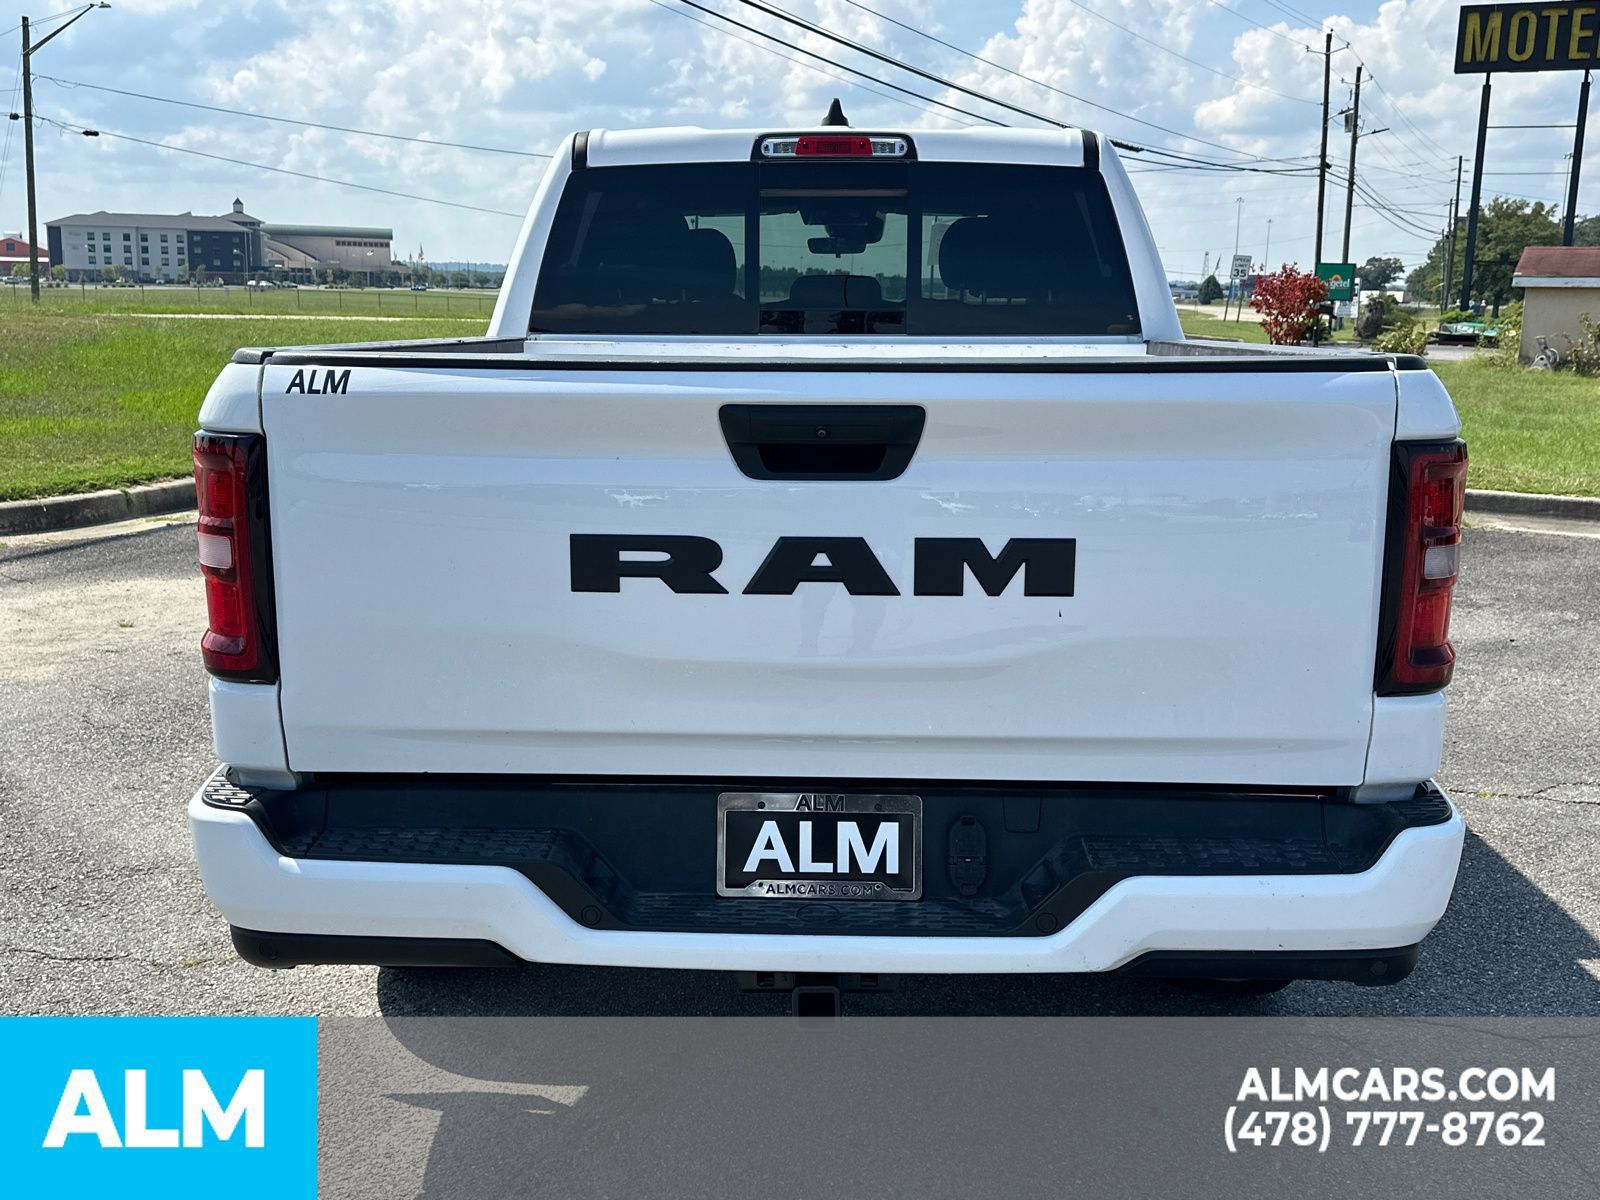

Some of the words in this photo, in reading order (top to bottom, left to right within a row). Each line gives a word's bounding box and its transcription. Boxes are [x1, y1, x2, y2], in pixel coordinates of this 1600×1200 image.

[1462, 7, 1600, 64] MOTE
[1233, 268, 1247, 278] 35
[285, 369, 351, 396] ALM
[570, 533, 1077, 597] RAM
[794, 794, 846, 812] ALM
[742, 820, 900, 874] ALM
[765, 883, 874, 897] ALMCARS.COM
